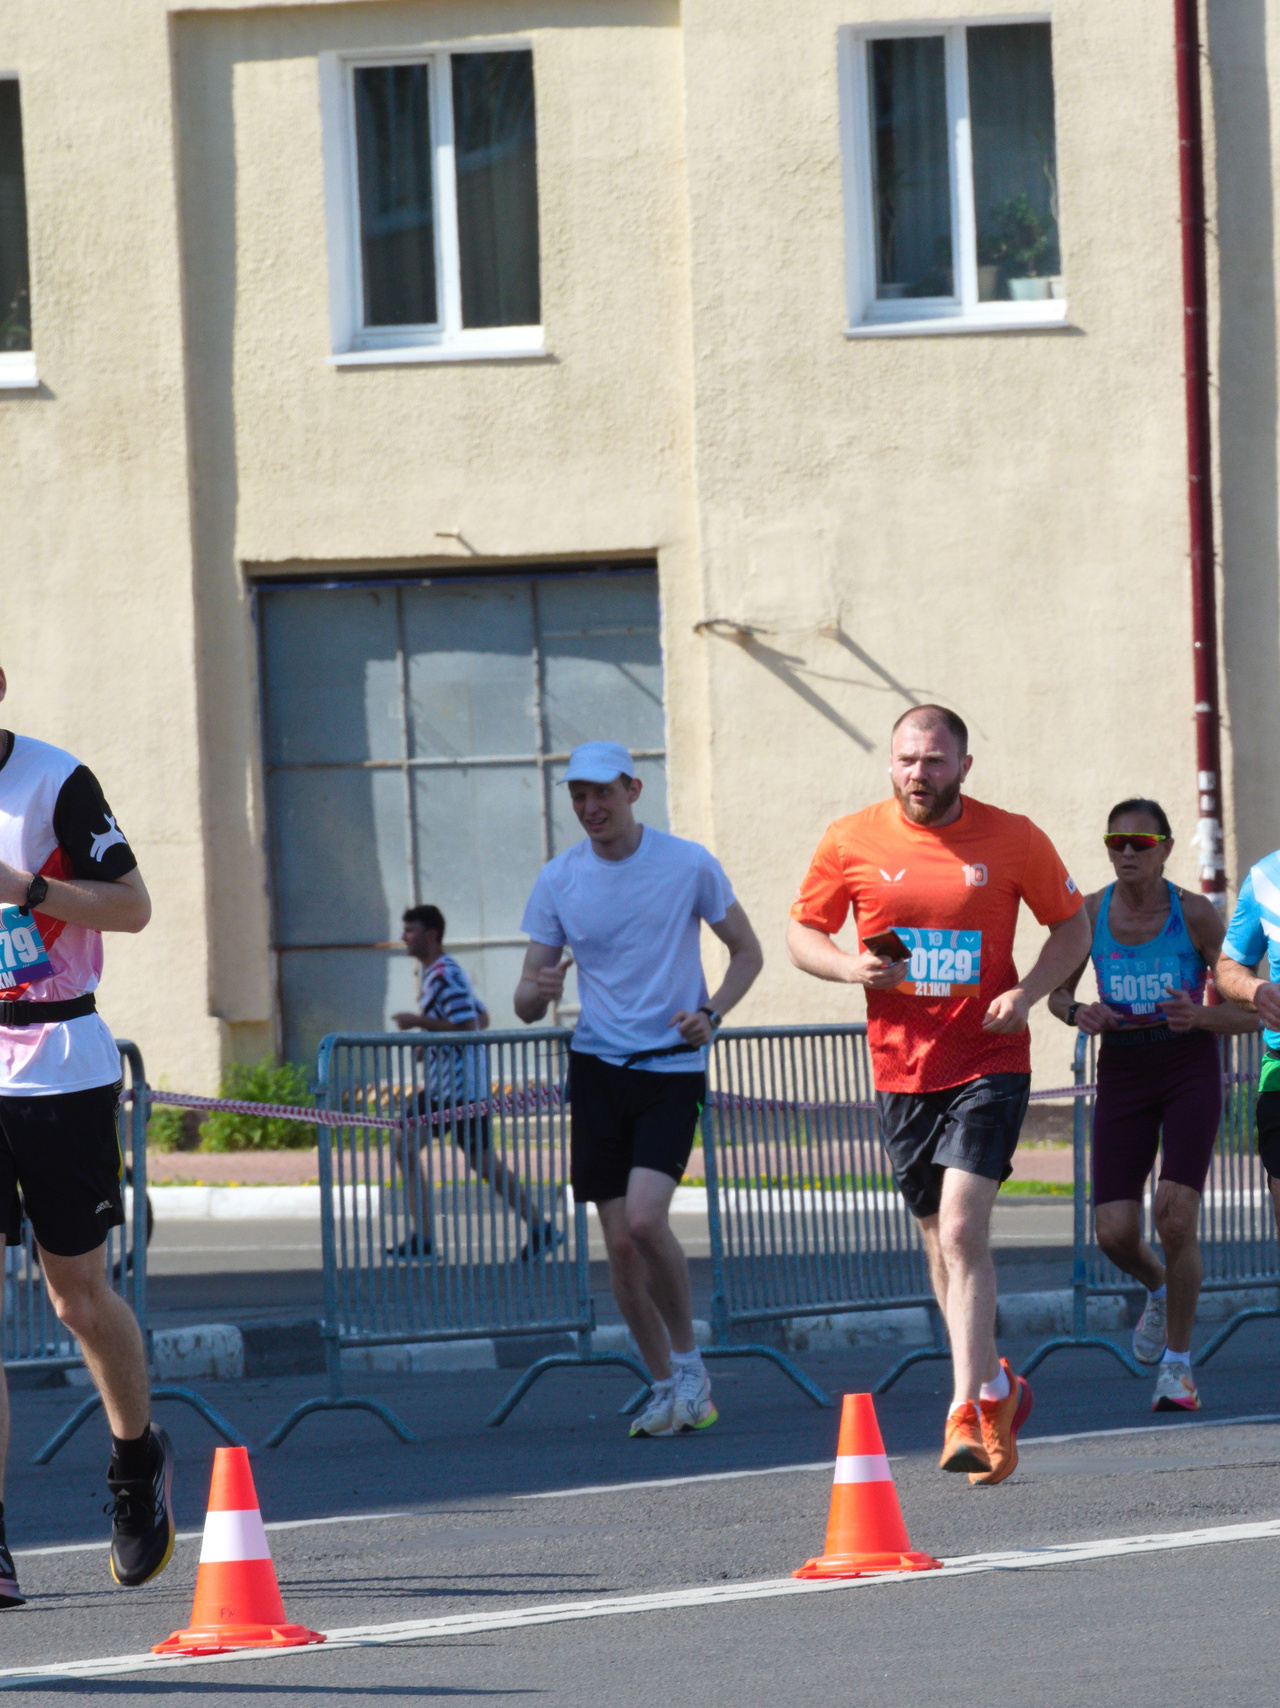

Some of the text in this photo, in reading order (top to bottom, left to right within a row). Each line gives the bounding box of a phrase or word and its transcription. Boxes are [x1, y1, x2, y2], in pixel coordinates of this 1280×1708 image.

[0, 926, 39, 970] 79
[903, 946, 972, 982] 0129
[1110, 972, 1173, 1002] 50153
[1131, 1002, 1156, 1015] 10KM
